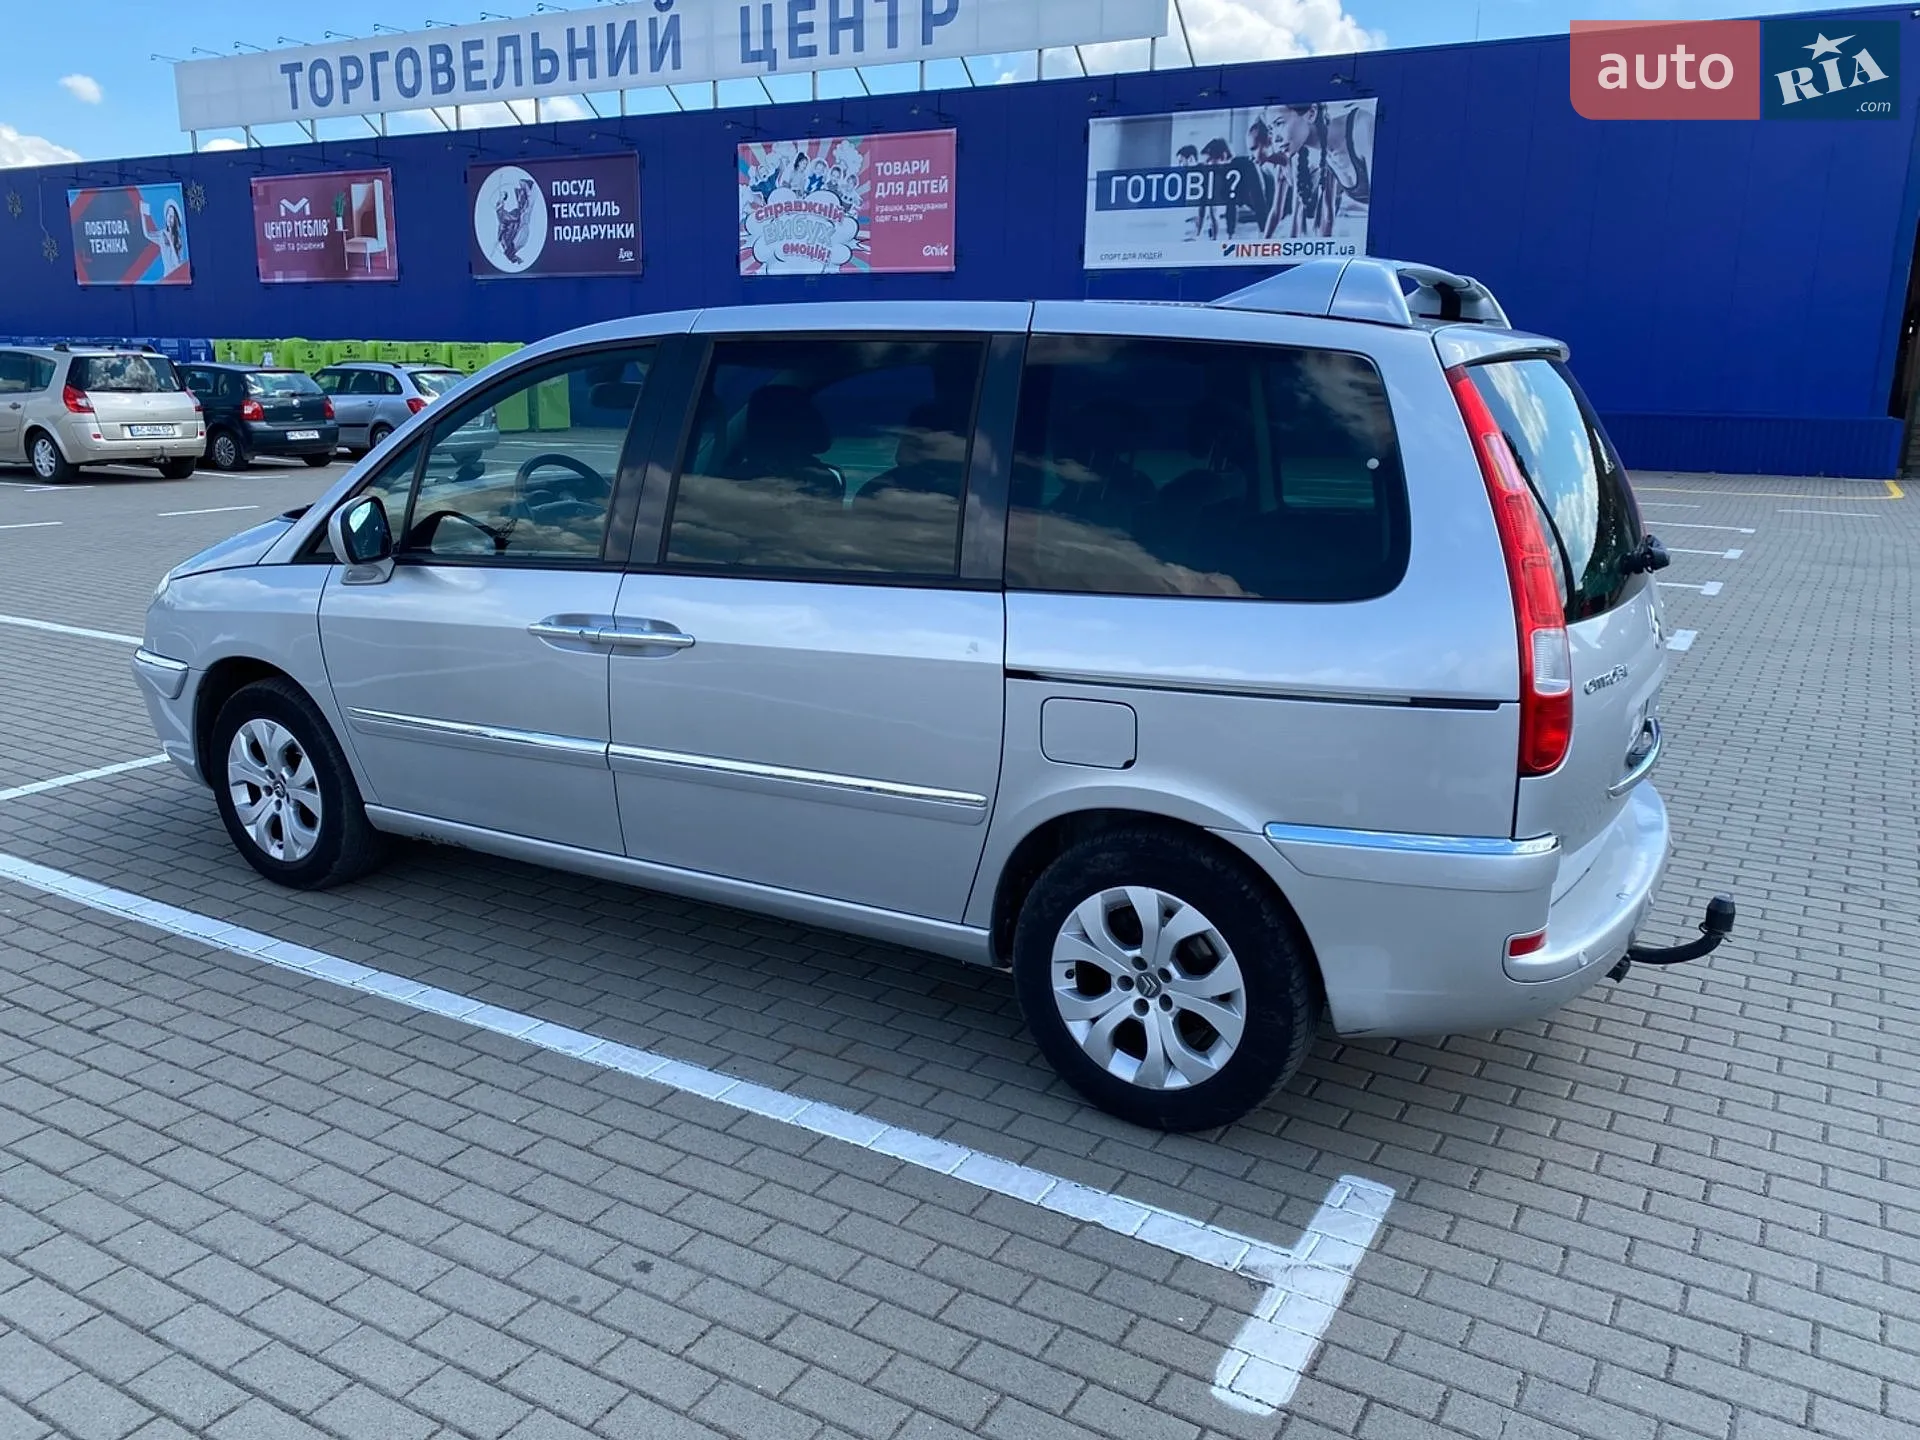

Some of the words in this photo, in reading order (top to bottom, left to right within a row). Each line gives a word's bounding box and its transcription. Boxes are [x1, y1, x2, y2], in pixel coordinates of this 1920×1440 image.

[279, 0, 682, 110] ТОРГОВЕЛЬНИЙ
[740, 0, 960, 72] ЦЕНТР
[875, 160, 930, 176] ТОВАРИ
[552, 179, 596, 197] ПОСУД
[875, 181, 905, 199] ДЛЯ
[907, 175, 949, 197] ДІТЕЙ
[1109, 169, 1216, 204] ГОТОВІ
[1225, 169, 1243, 199] ?
[552, 201, 621, 219] ТЕКСТИЛЬ
[84, 219, 130, 236] ПОБУТОВА
[264, 221, 293, 240] ЦЕНТР
[554, 223, 636, 243] ПОДАРУНКИ
[89, 238, 129, 254] ТЕХНІКА
